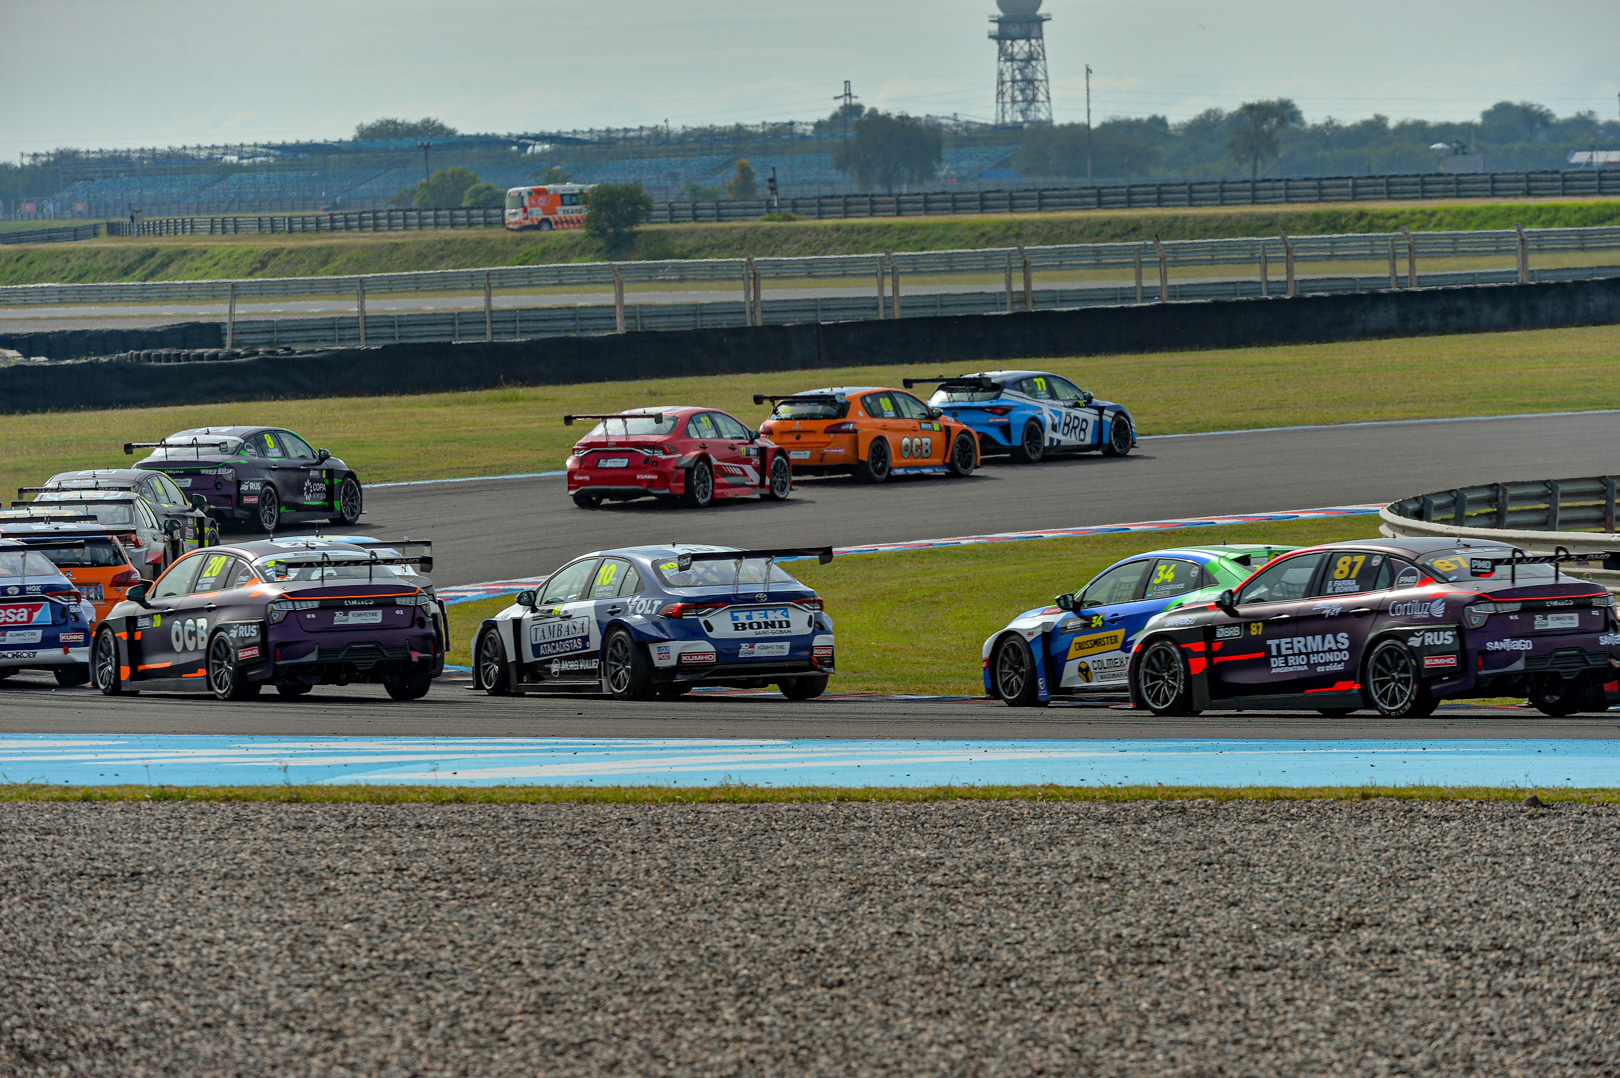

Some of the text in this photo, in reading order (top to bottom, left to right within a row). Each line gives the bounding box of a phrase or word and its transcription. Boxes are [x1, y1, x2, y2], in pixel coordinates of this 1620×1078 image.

[1033, 377, 1047, 391] 77
[700, 416, 712, 430] 17
[1061, 411, 1089, 443] BRB
[264, 433, 275, 449] 8
[901, 436, 932, 459] OCB
[249, 482, 262, 491] RUS
[312, 483, 327, 492] COPA
[203, 555, 227, 577] 20
[660, 562, 679, 571] 10
[1333, 555, 1367, 580] 87
[1432, 556, 1470, 572] 87
[1471, 559, 1492, 569] PMO
[596, 563, 617, 586] 10
[1153, 563, 1177, 584] 34
[1398, 575, 1418, 584] PMO
[626, 595, 663, 616] VOLT
[1388, 599, 1431, 617] Cortiluz
[733, 609, 784, 621] TEK
[1091, 615, 1104, 628] 34
[238, 624, 258, 638] RUS
[533, 620, 586, 642] TAMBASA
[732, 619, 791, 632] BOND
[1224, 626, 1241, 637] BRB
[1250, 622, 1263, 636] 87
[171, 617, 209, 653] OCB
[1424, 630, 1454, 646] RUS
[540, 638, 583, 656] ATACADISTAS
[1074, 635, 1119, 652] CROSSMASTER
[1266, 632, 1350, 656] TERMAS
[681, 654, 715, 662] KUMHO
[814, 648, 832, 656] KUMHO
[1269, 650, 1350, 668] DE RIO HONDO
[1270, 664, 1309, 674] ARGENTINA
[1424, 657, 1456, 666] KUMHO
